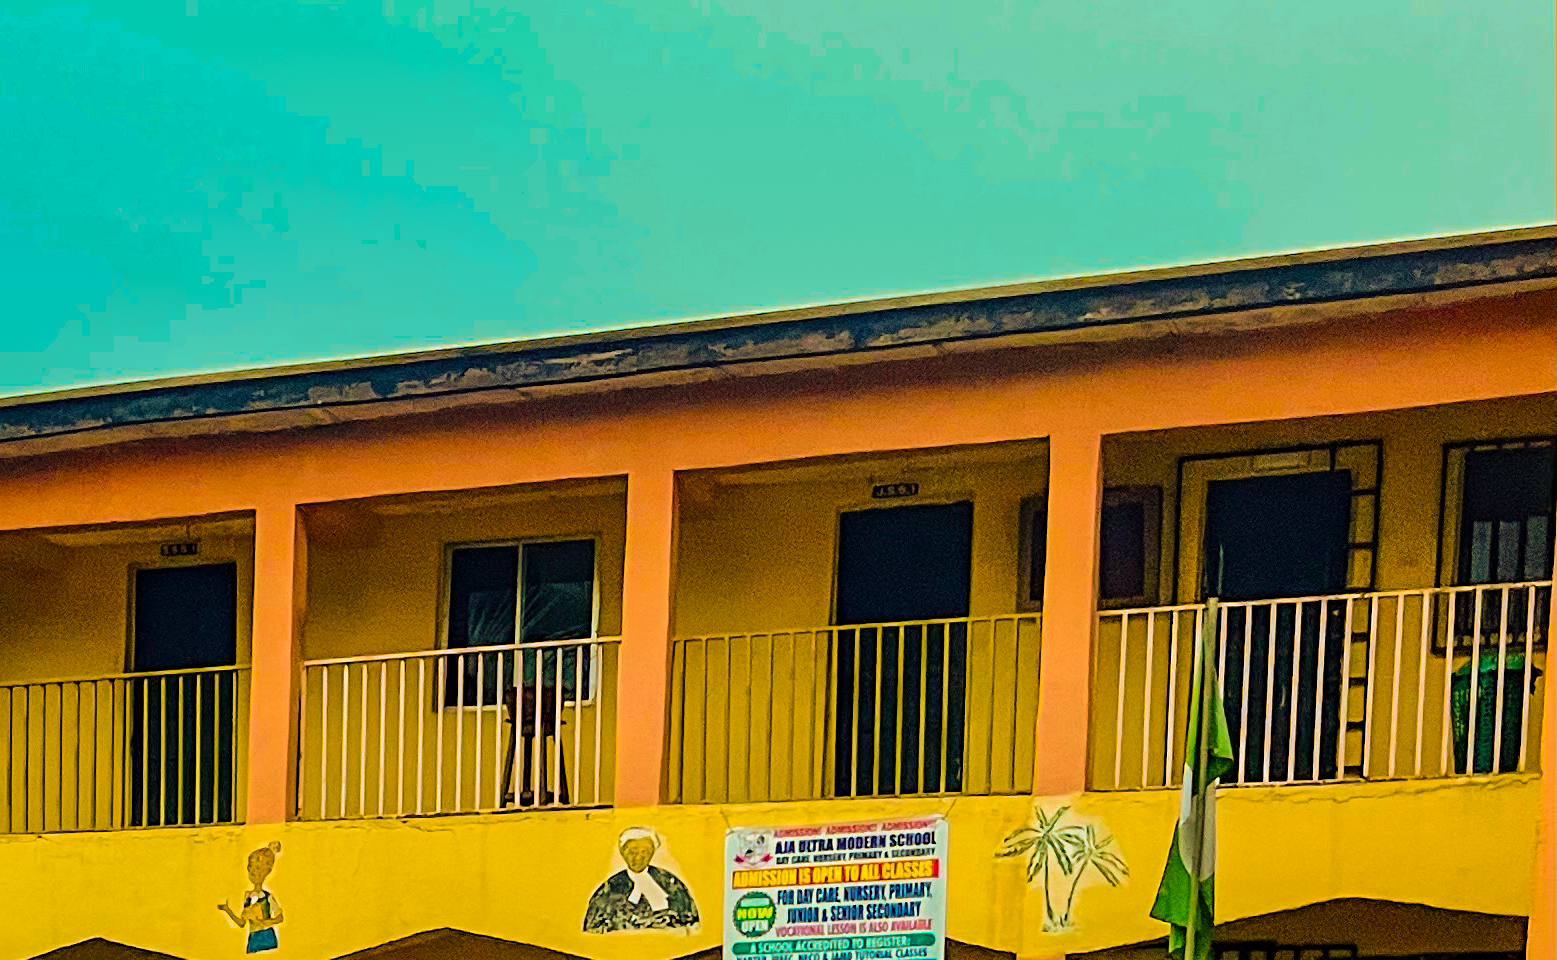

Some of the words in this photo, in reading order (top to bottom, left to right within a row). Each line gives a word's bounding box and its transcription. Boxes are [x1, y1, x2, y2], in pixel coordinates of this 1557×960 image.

[775, 840, 795, 855] AJA
[799, 838, 834, 853] ULTRA
[836, 834, 887, 851] MODERN
[889, 831, 937, 847] SCHOOL
[733, 868, 797, 888] ADMISSION
[799, 867, 811, 884] IS
[812, 865, 842, 884] OPEN
[845, 864, 860, 882] TO
[861, 863, 880, 881] ALL
[882, 860, 933, 880] CLASSES
[777, 889, 795, 905] FOR
[797, 888, 814, 905] DAY
[737, 906, 773, 920] NOW
[787, 907, 819, 924] JUNIOR
[821, 908, 828, 922] &
[830, 904, 864, 921] SENIOR
[866, 901, 921, 920] SECONDARY
[775, 923, 825, 938] VOCATIONAL
[827, 922, 856, 935] LESSON
[858, 922, 867, 934] IS
[869, 921, 889, 933] ALSO
[890, 918, 932, 931] AVAILABLE
[750, 942, 757, 954] A
[758, 942, 793, 954] SCHOOL
[795, 938, 850, 952] ACCREDITED
[852, 937, 864, 949] TO
[895, 947, 928, 958] CLASSES
